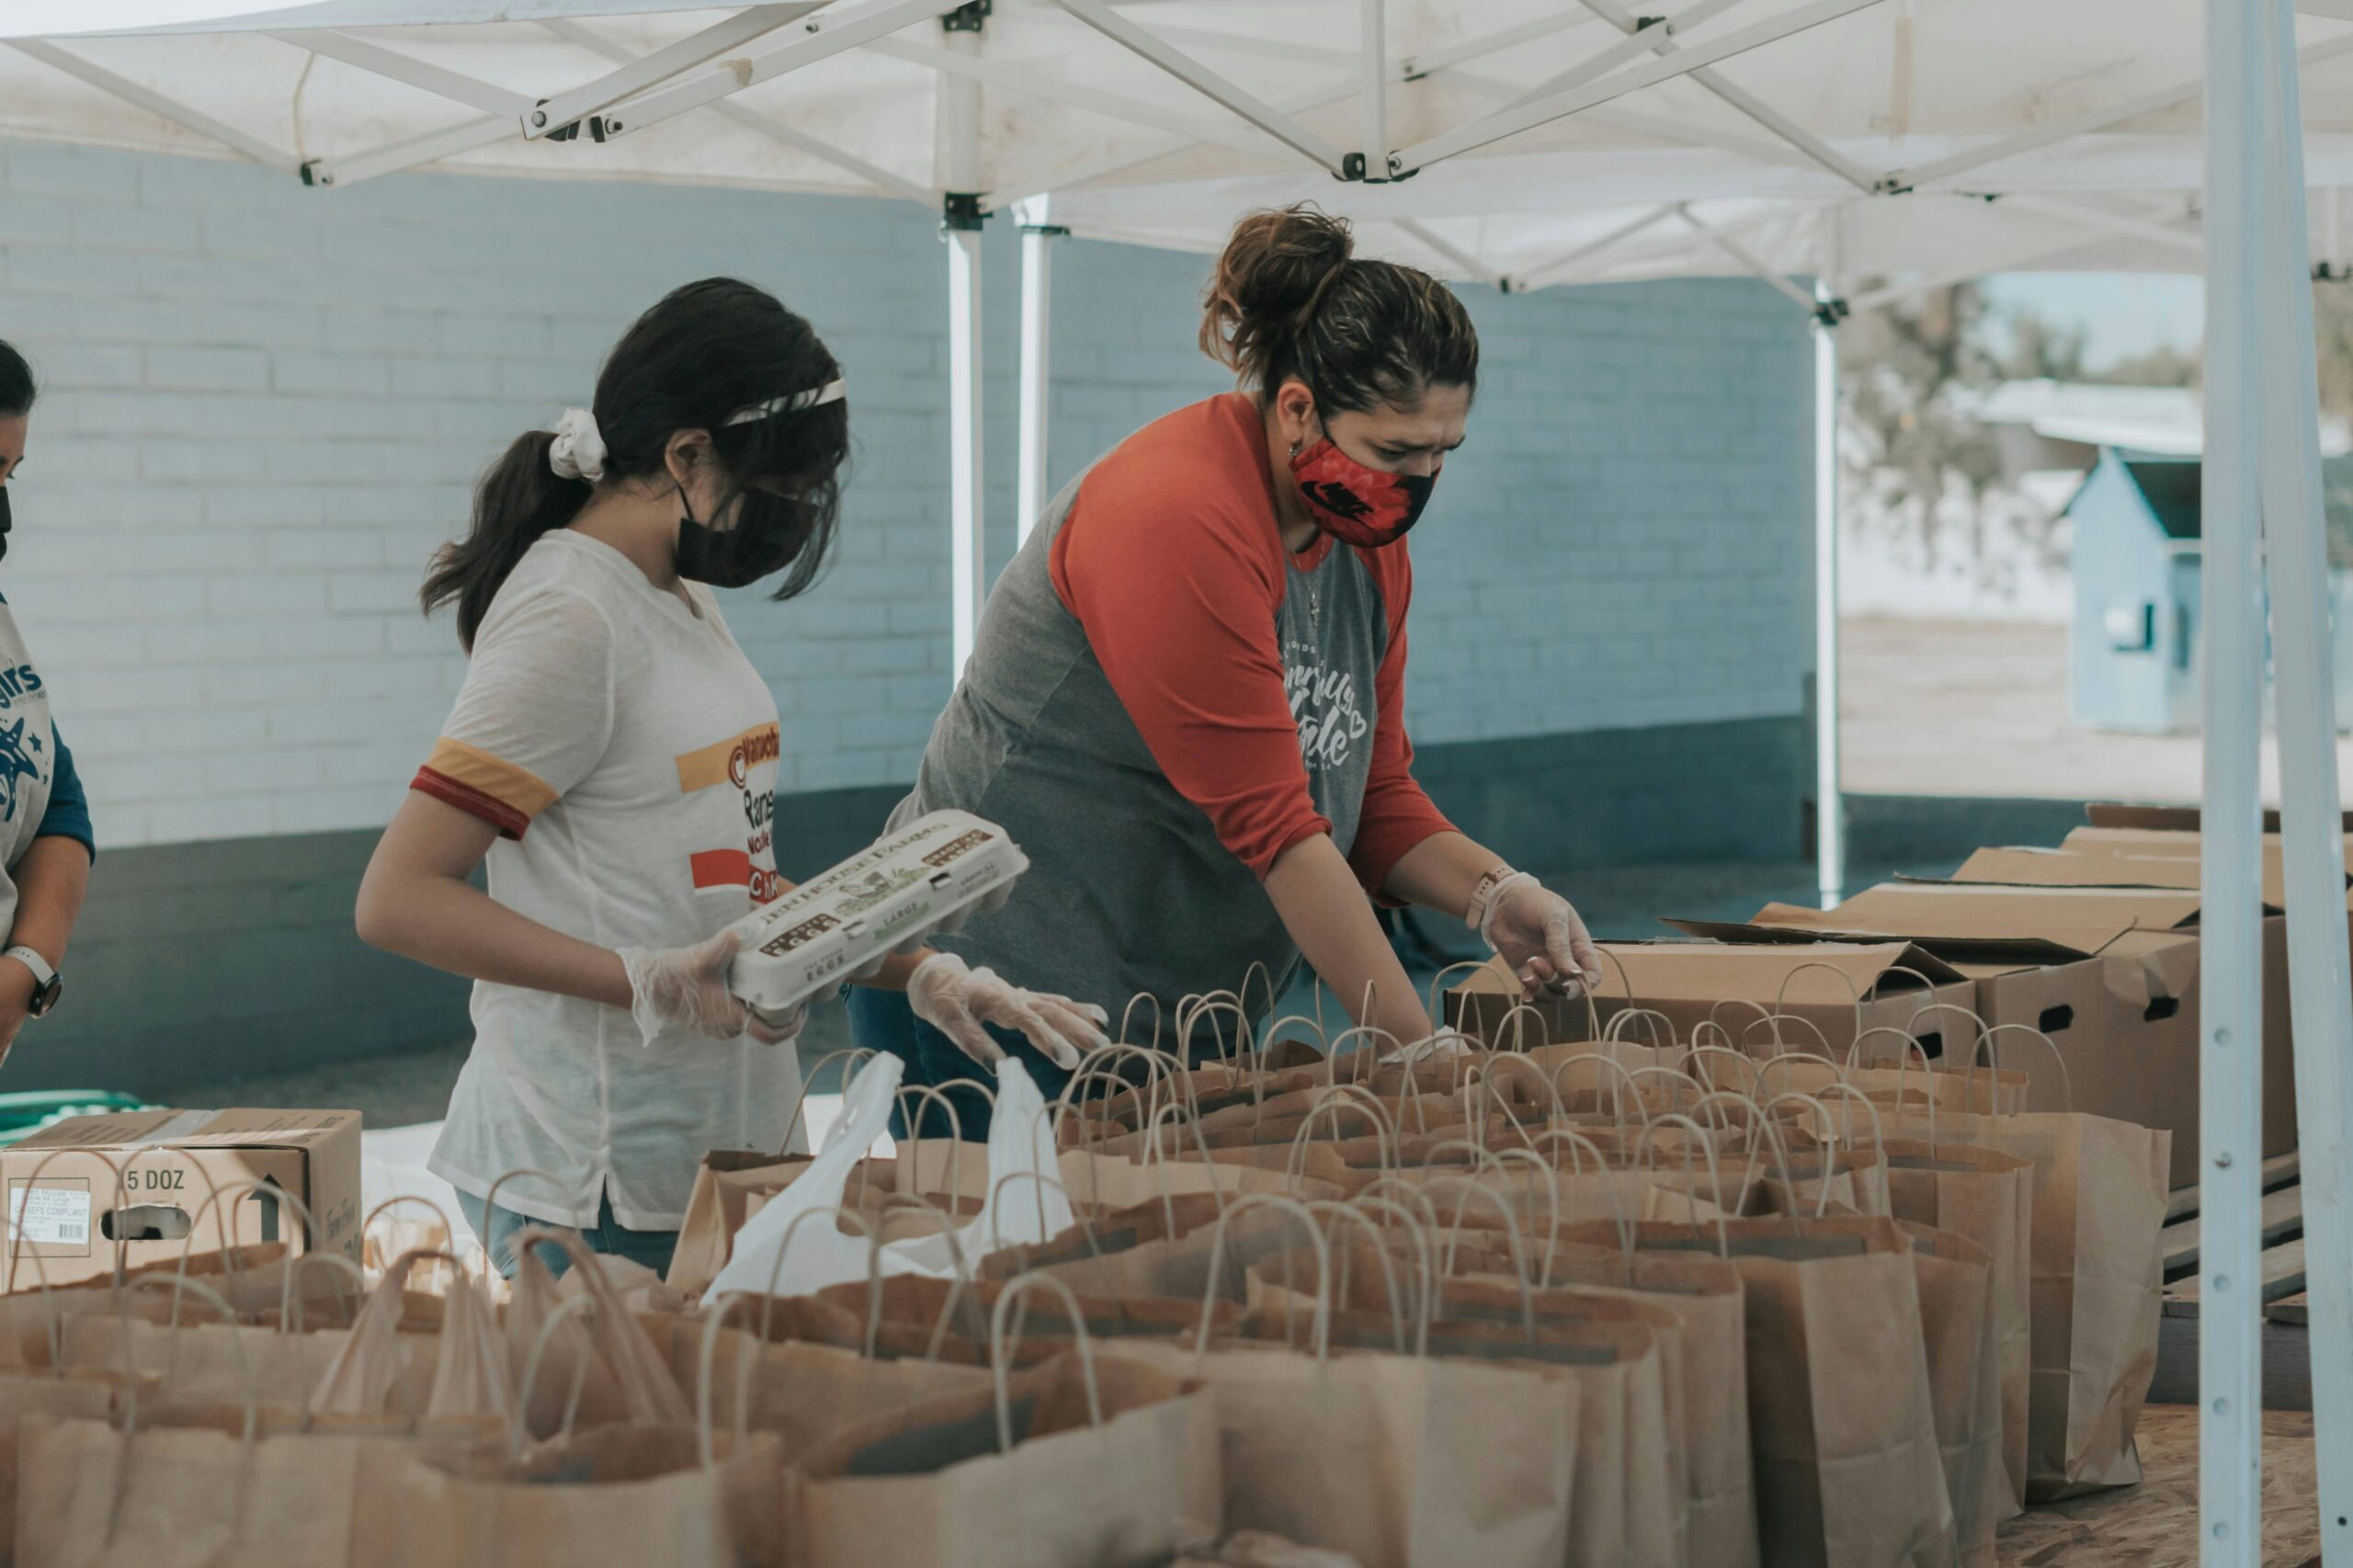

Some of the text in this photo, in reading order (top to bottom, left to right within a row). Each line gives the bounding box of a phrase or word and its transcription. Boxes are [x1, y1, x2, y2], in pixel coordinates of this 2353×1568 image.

[801, 858, 872, 901] HOUSE
[872, 823, 949, 858] FARMS
[883, 901, 919, 926] LARGE
[773, 920, 839, 956] EGGS
[807, 954, 844, 982] EGGS
[128, 1170, 184, 1190] 5 DOZ
[46, 1207, 87, 1217] COMPLIANT
